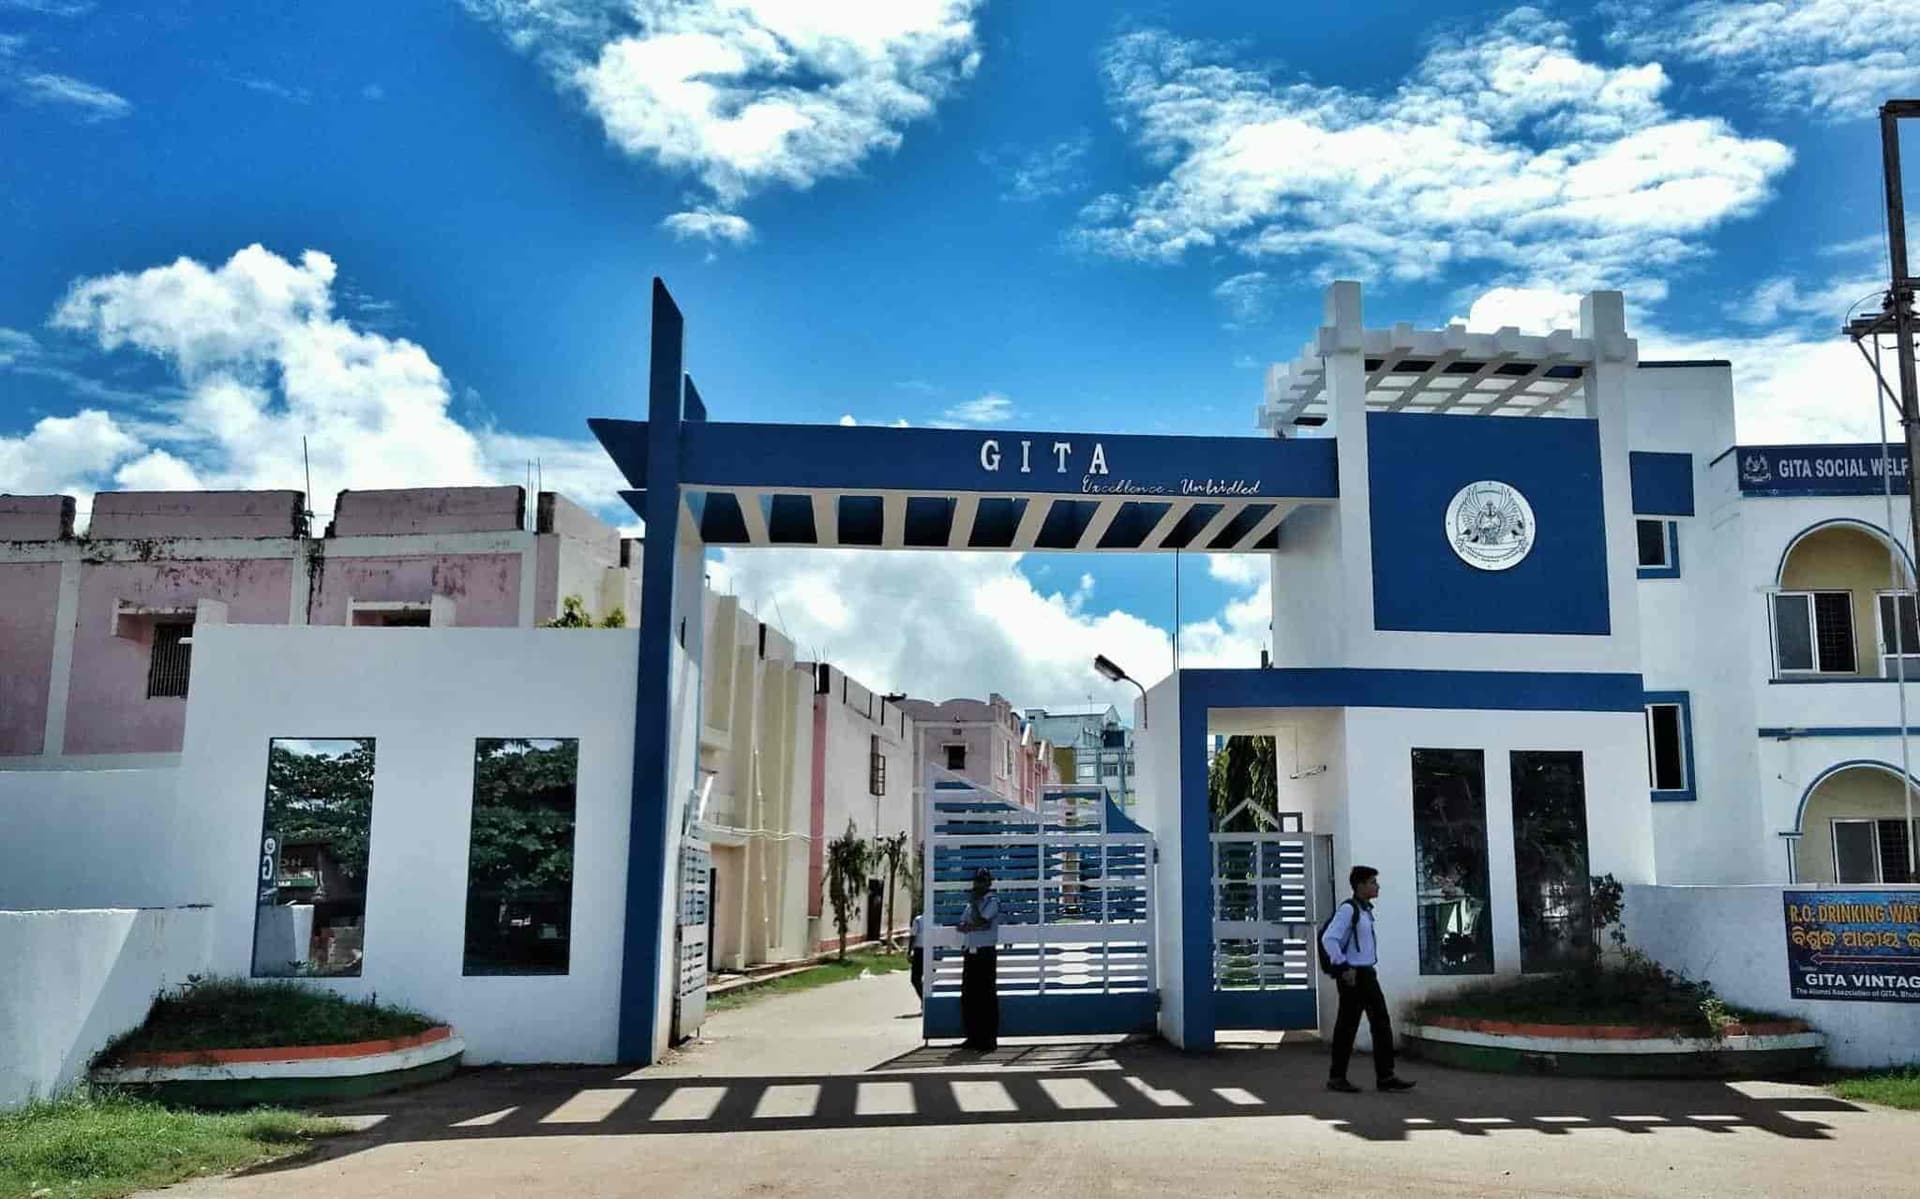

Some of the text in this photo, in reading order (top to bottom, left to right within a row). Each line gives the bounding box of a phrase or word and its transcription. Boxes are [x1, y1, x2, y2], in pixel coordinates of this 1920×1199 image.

[980, 439, 1110, 475] GITA
[1778, 459, 1812, 478] GITA
[1815, 458, 1868, 477] SOCIAL
[1081, 474, 1166, 494] Excellence
[1180, 478, 1261, 495] Unbridled
[1818, 904, 1885, 923] DRINKING
[1888, 905, 1920, 923] WAT
[1805, 973, 1847, 986] GITA
